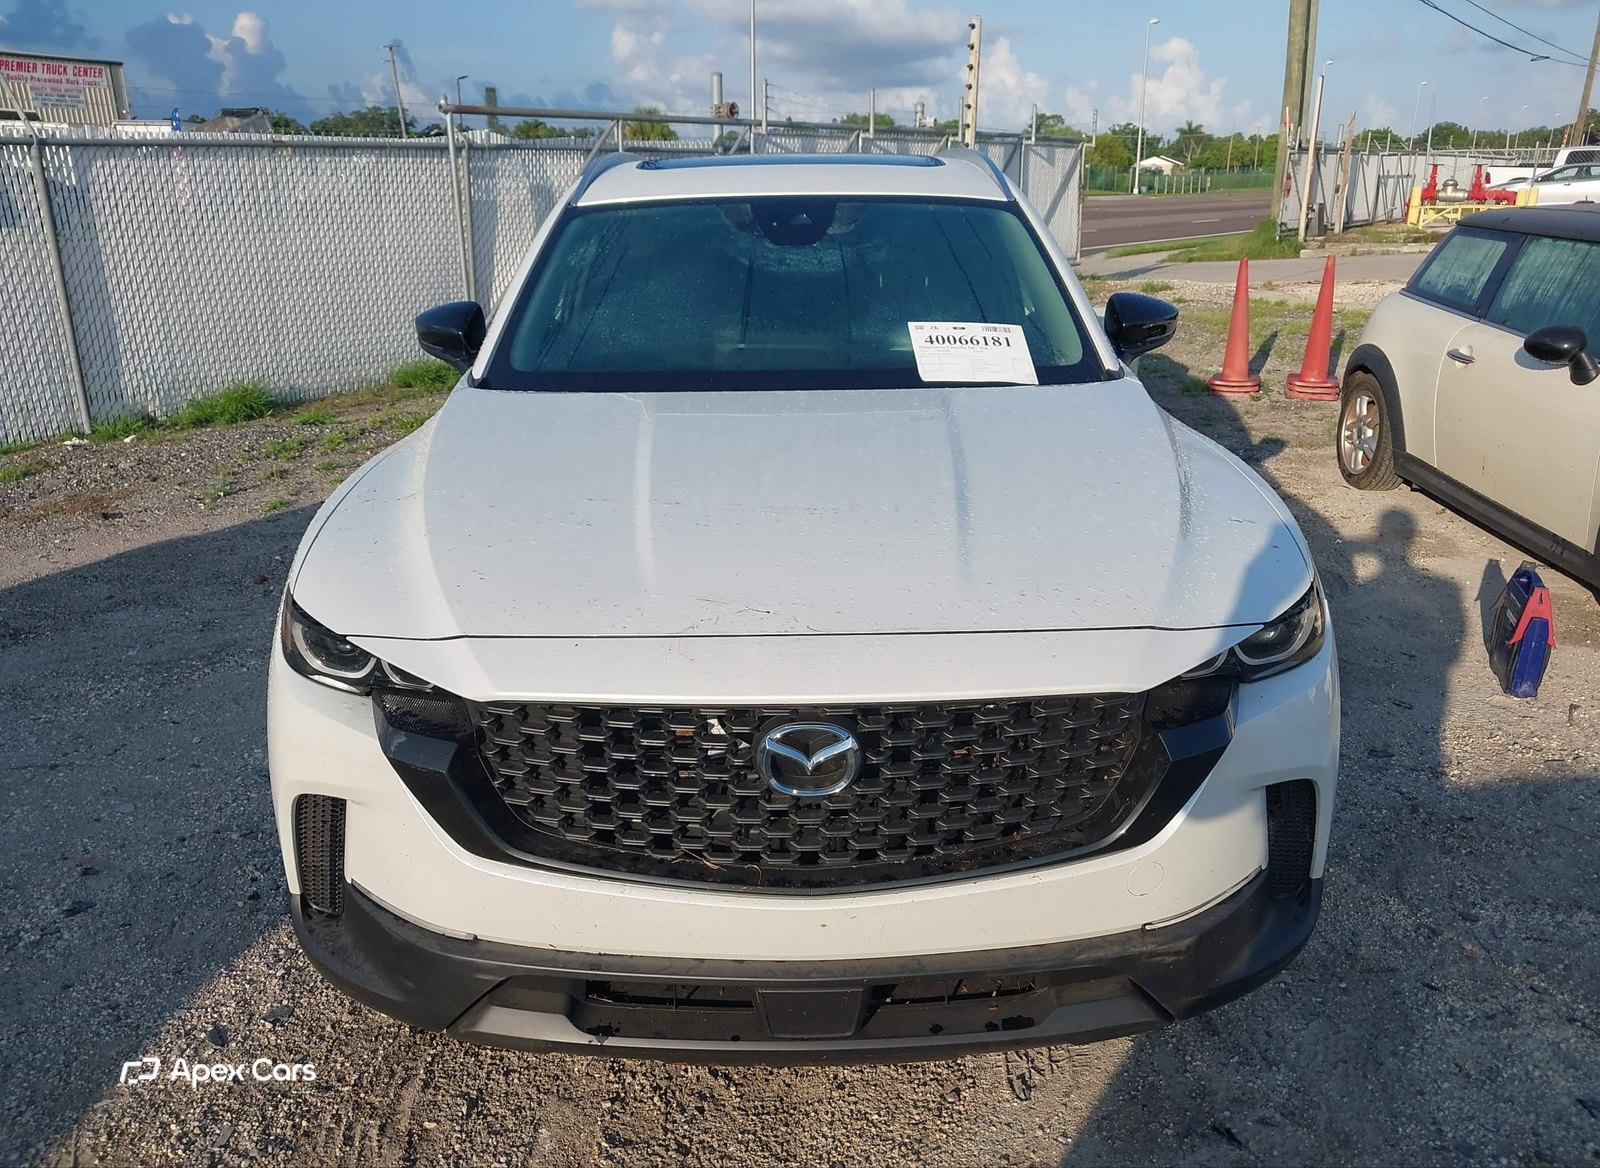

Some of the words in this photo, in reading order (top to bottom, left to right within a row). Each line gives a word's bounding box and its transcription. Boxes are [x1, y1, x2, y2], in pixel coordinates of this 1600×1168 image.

[0, 60, 37, 73] PREMIER
[41, 63, 68, 76] TRUCK
[73, 66, 103, 78] CENTER
[65, 78, 80, 86] Work
[924, 334, 1012, 348] 40066181
